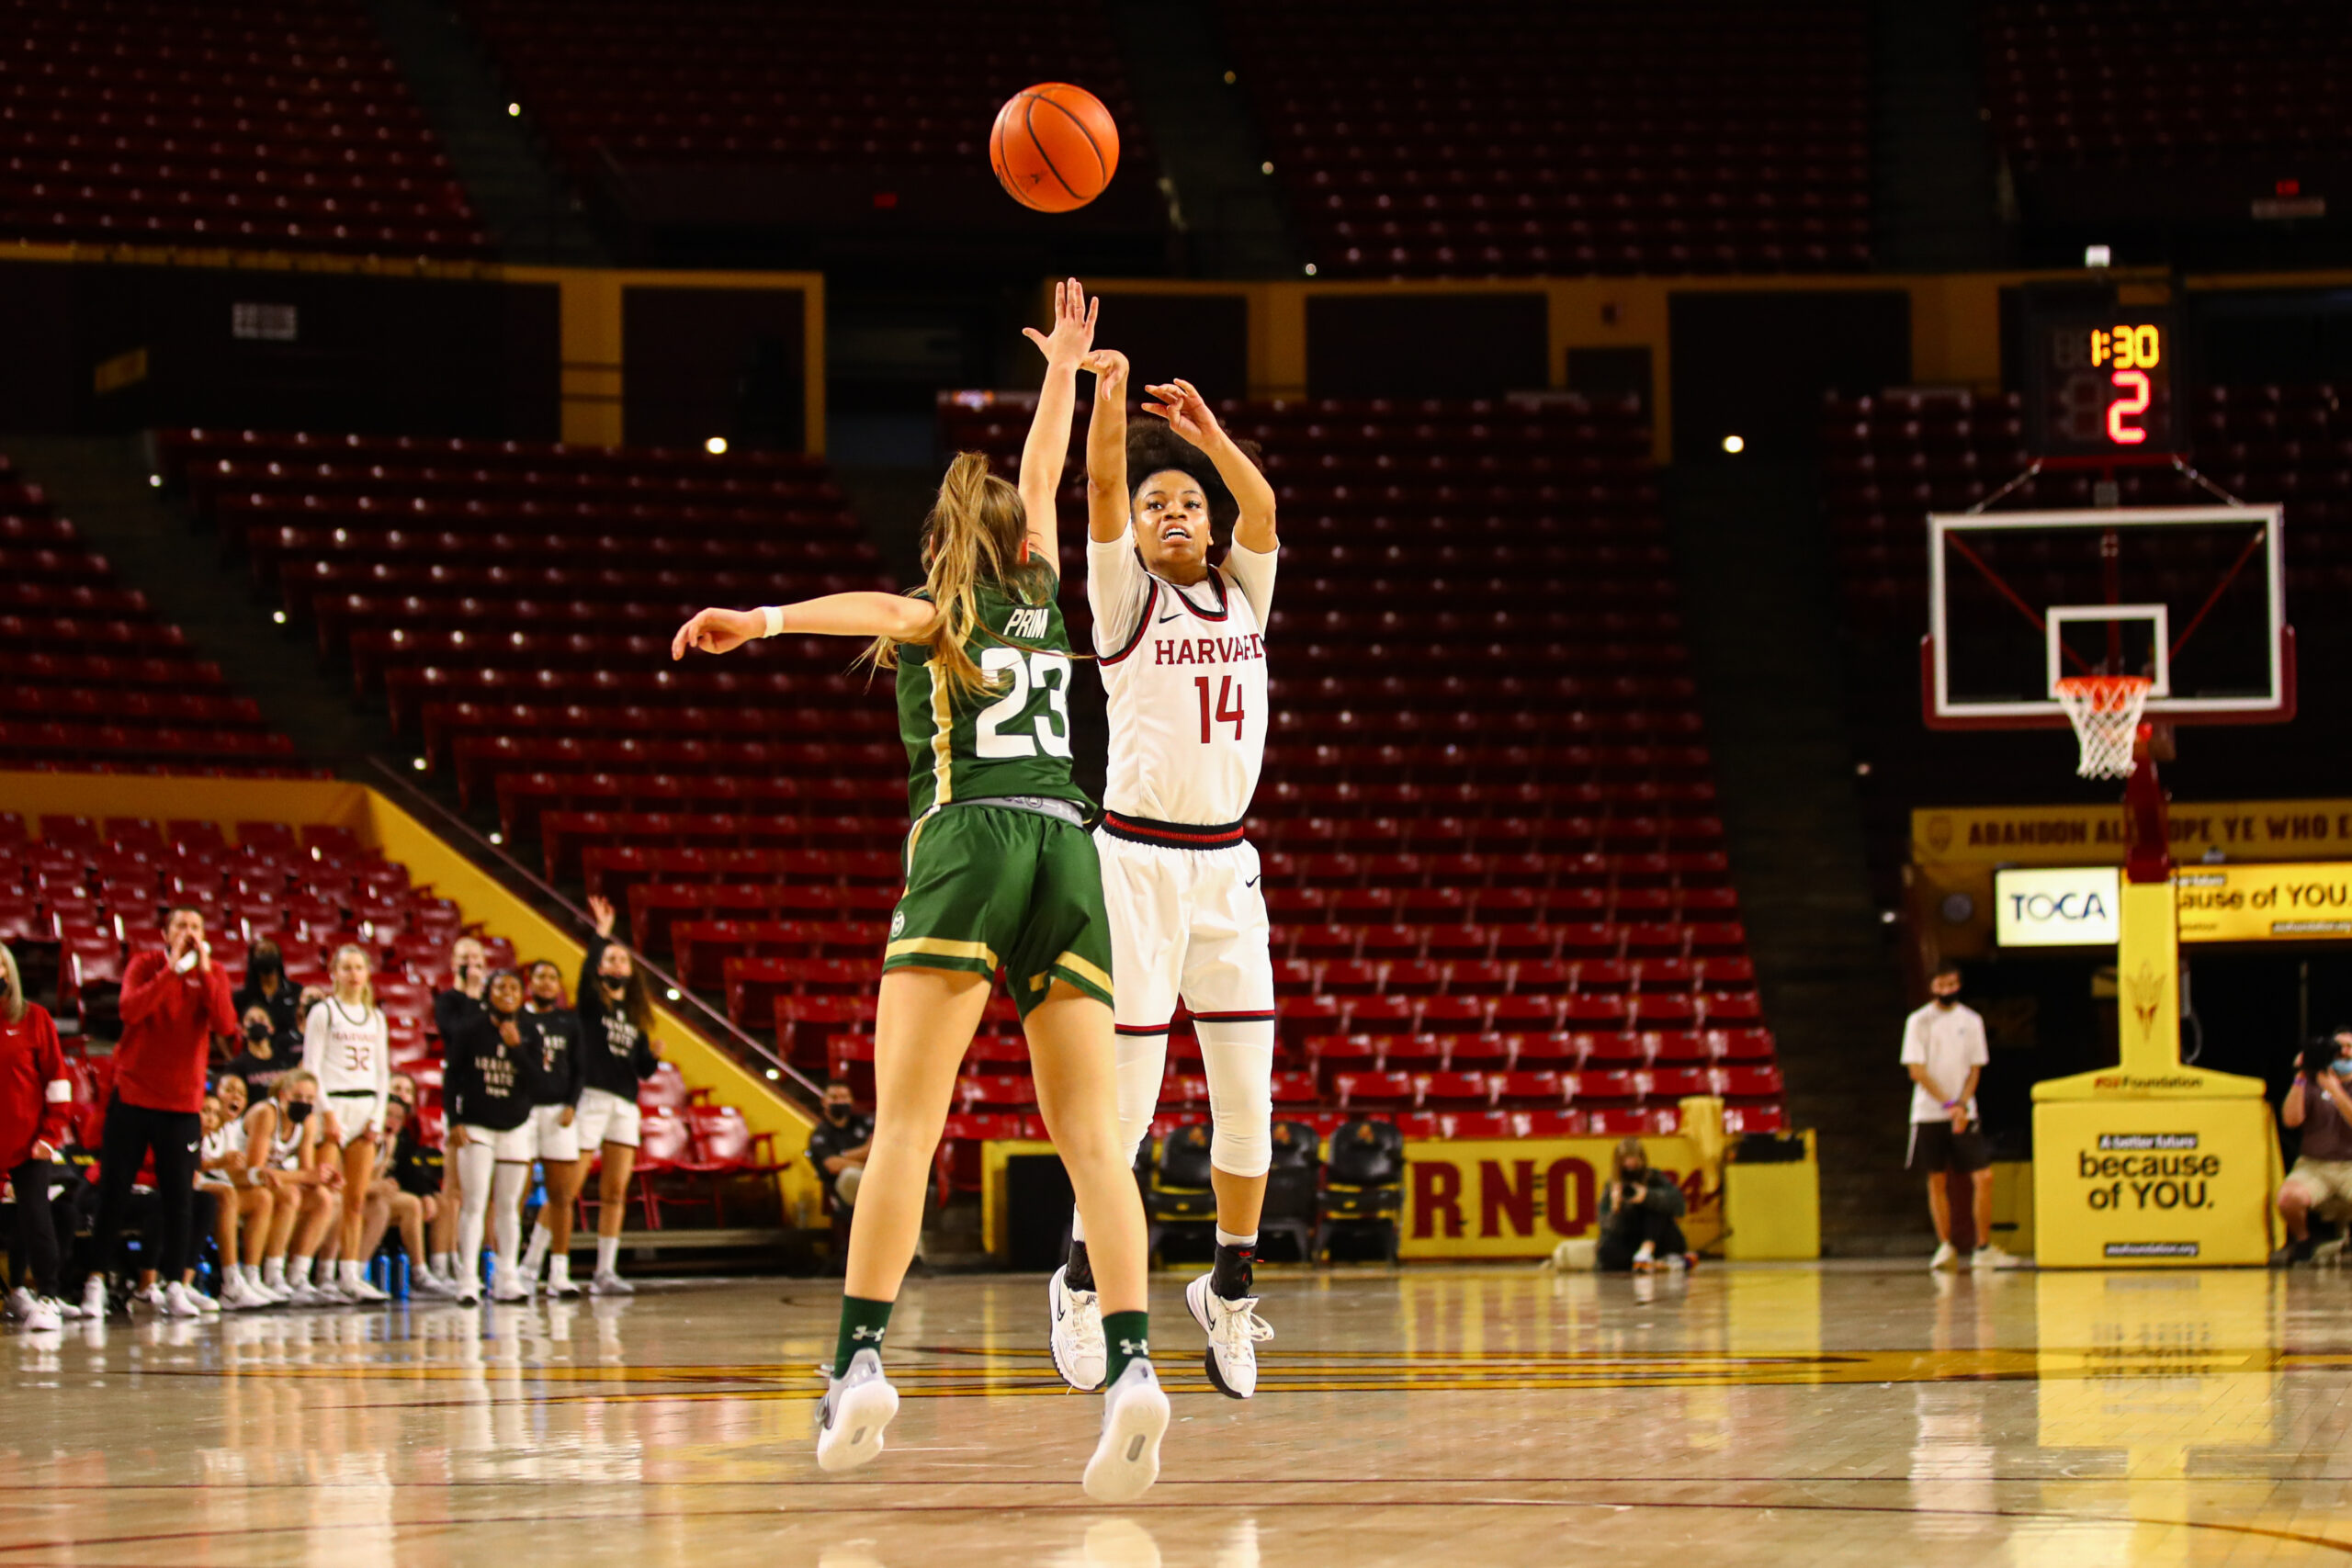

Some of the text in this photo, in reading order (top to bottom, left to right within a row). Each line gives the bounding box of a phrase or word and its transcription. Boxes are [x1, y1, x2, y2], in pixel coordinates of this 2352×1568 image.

[2091, 324, 2159, 369] 1:30
[2107, 370, 2151, 444] 2
[1003, 608, 1049, 639] PRIM
[976, 646, 1074, 759] 23
[1194, 675, 1245, 744] 14
[1968, 820, 2087, 846] ABANDON
[2096, 818, 2127, 843] AL
[2168, 816, 2212, 842] OPE
[2223, 816, 2256, 841] YE
[2265, 814, 2328, 840] WHO
[2009, 893, 2106, 920] TOCA
[2181, 890, 2244, 909] ause
[2252, 885, 2277, 908] of
[345, 1045, 369, 1071] 32
[2079, 1150, 2220, 1179] because
[2088, 1180, 2214, 1210] of YOU.
